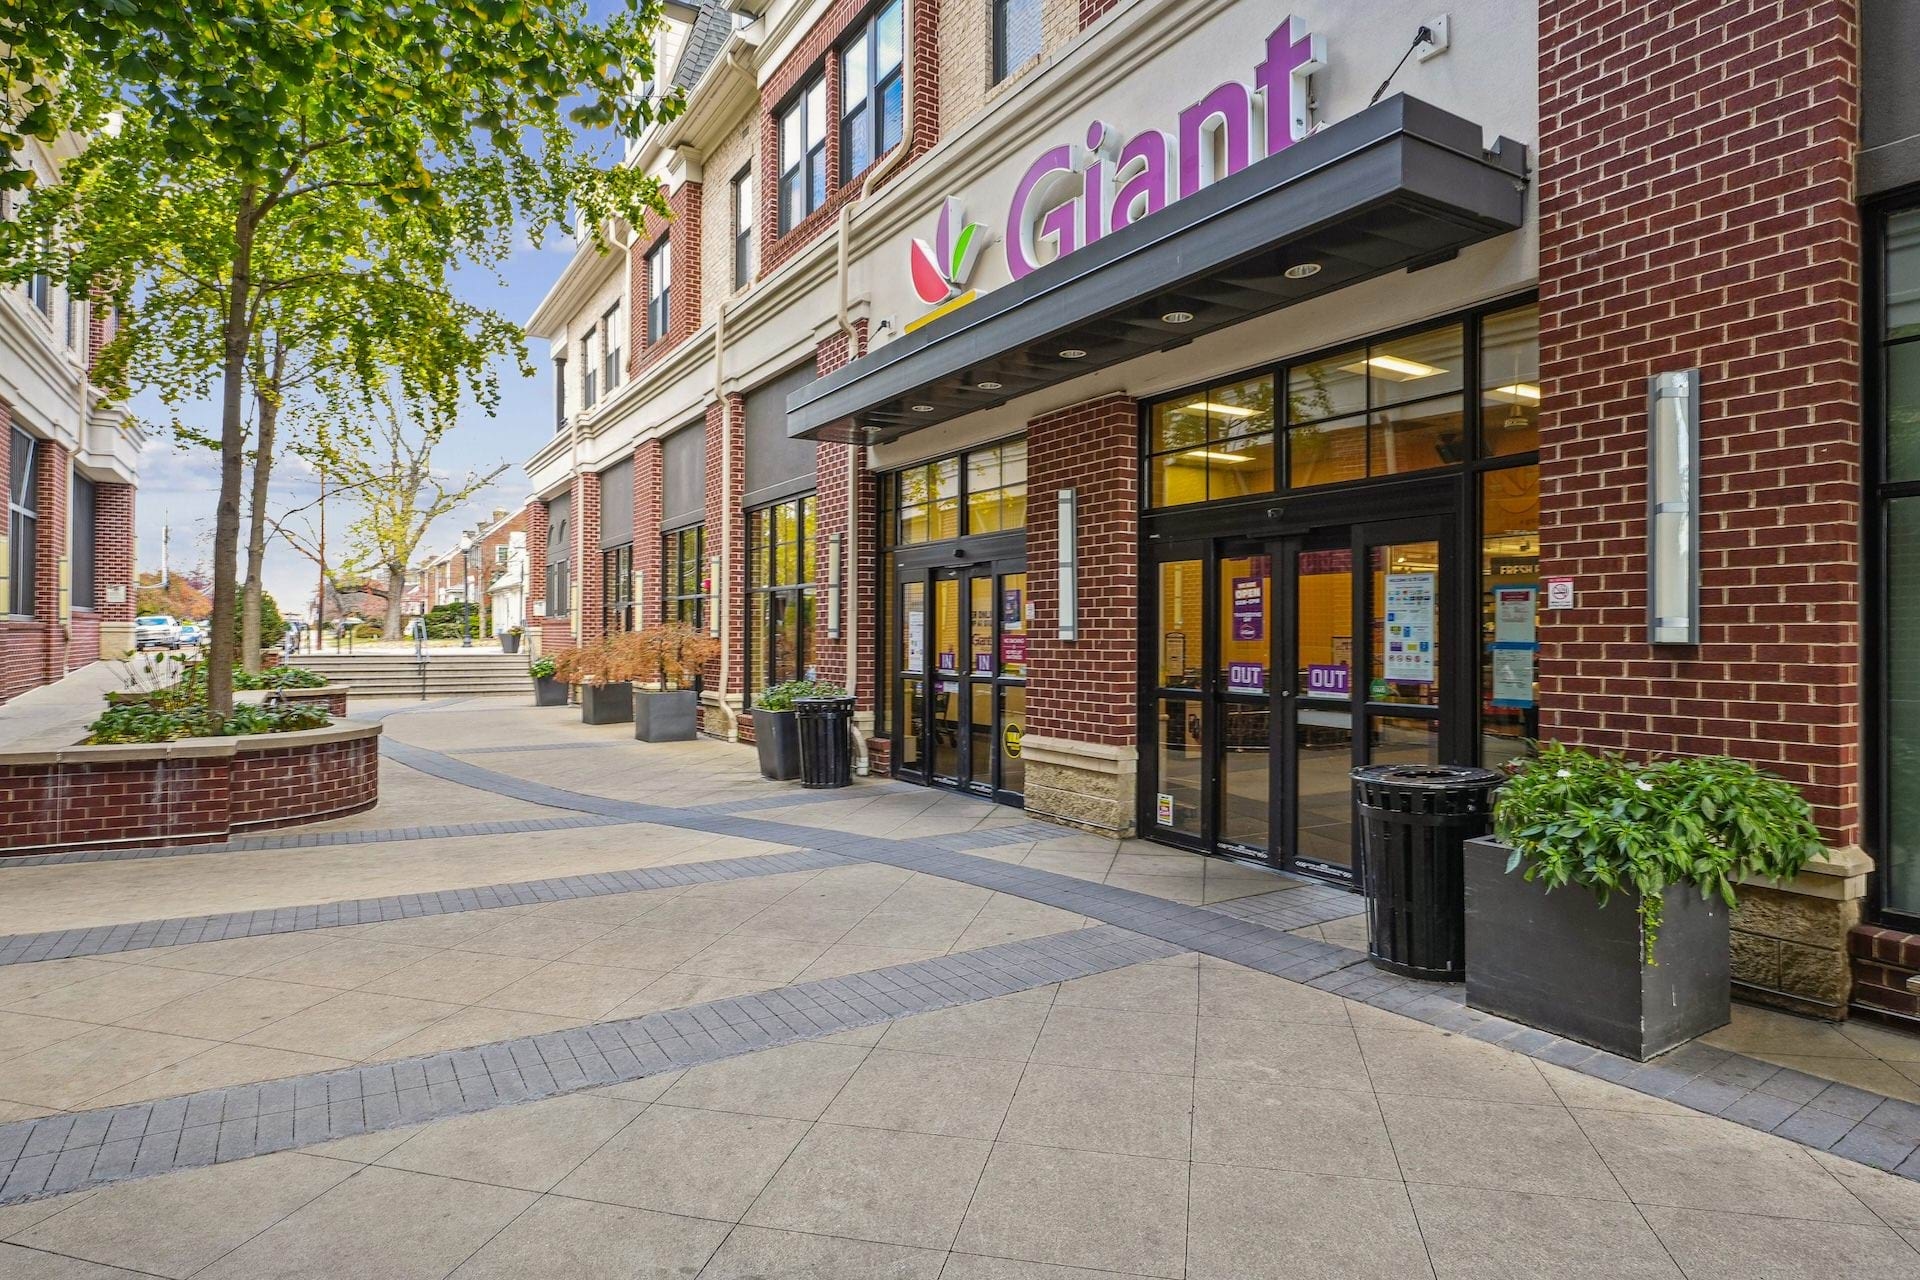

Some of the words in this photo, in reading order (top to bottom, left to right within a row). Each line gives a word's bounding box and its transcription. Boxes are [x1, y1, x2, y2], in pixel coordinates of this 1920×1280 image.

[1006, 14, 1318, 282] Giant
[1500, 565, 1533, 575] FRESH
[1235, 588, 1261, 599] OPEN
[941, 654, 953, 669] IN
[978, 655, 990, 670] IN
[1230, 666, 1262, 685] OUT
[1310, 669, 1347, 689] OUT
